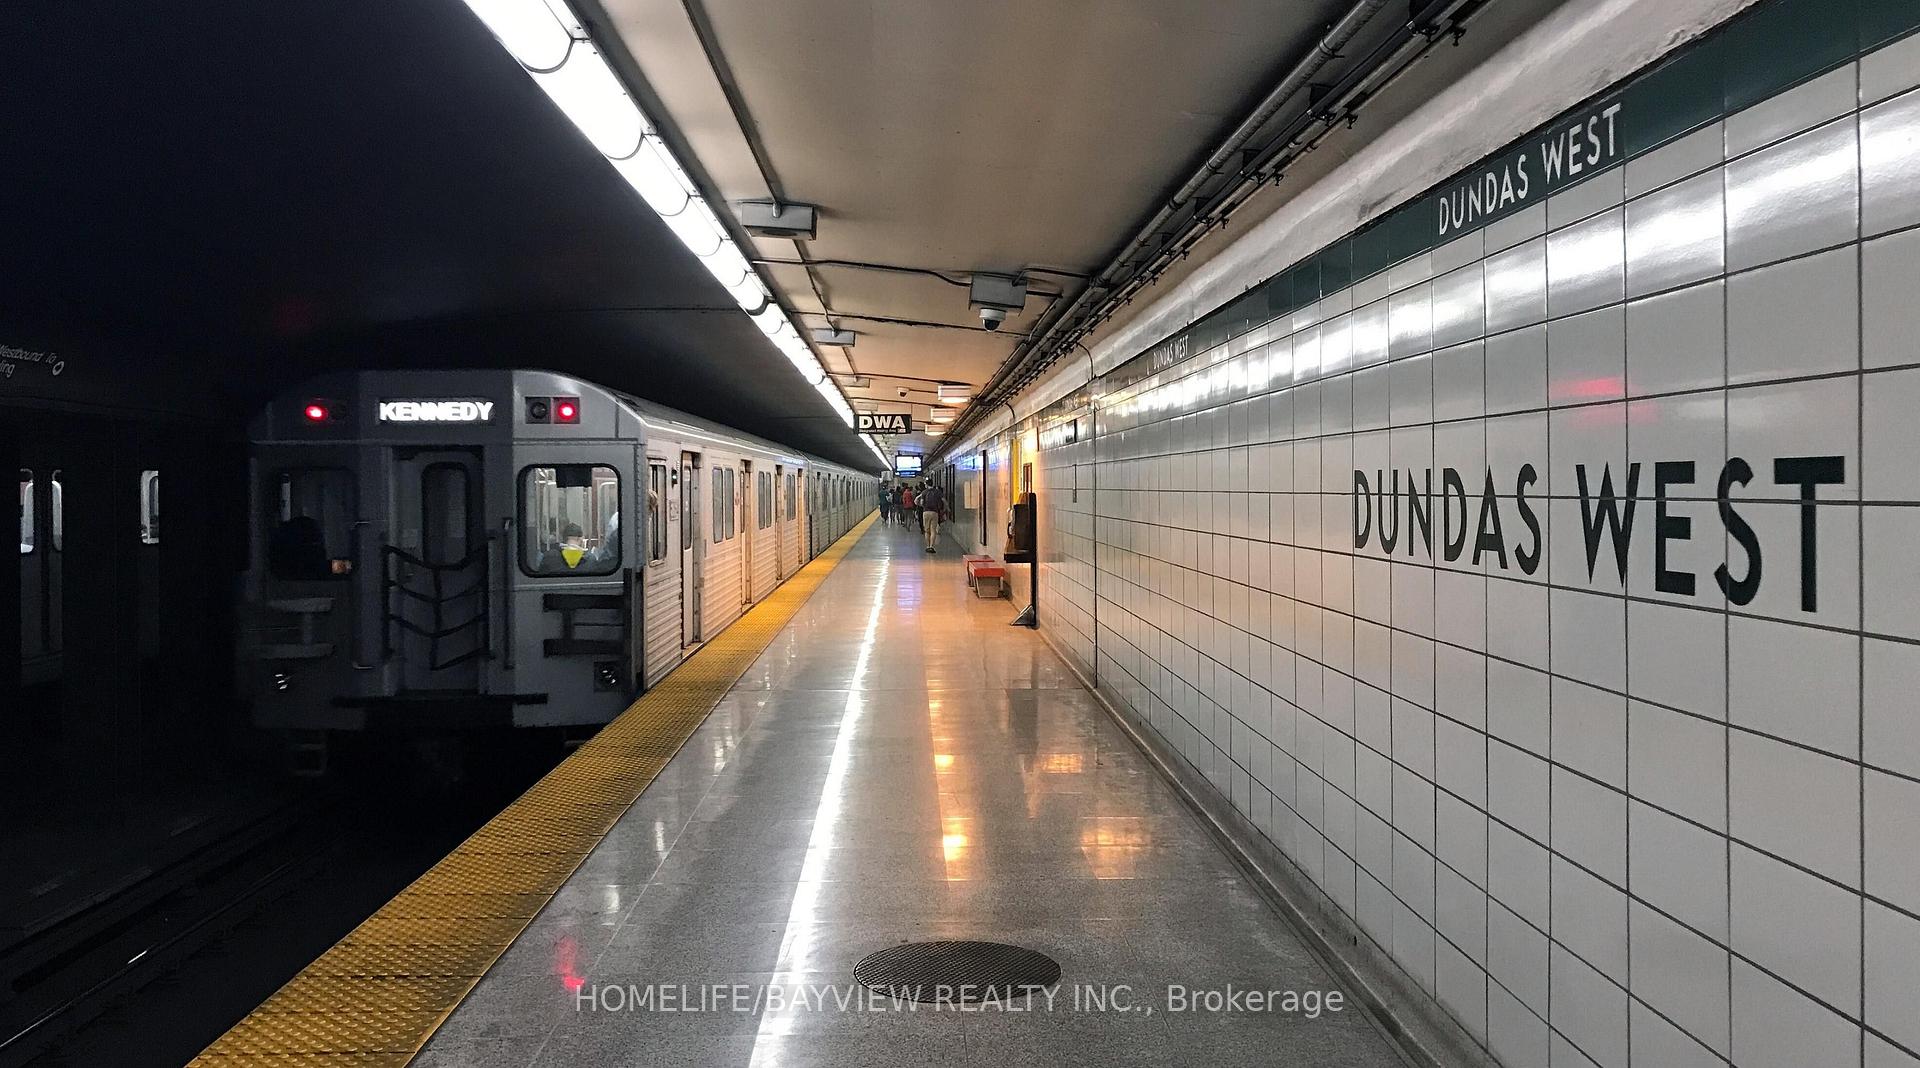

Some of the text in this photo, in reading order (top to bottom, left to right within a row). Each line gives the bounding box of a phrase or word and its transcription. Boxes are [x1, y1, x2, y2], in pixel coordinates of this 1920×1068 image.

[1438, 103, 1621, 236] DUNDAS WEST
[379, 401, 494, 421] KENNEDY
[858, 415, 906, 429] DWA
[1353, 456, 1845, 612] DUNDAS WEST
